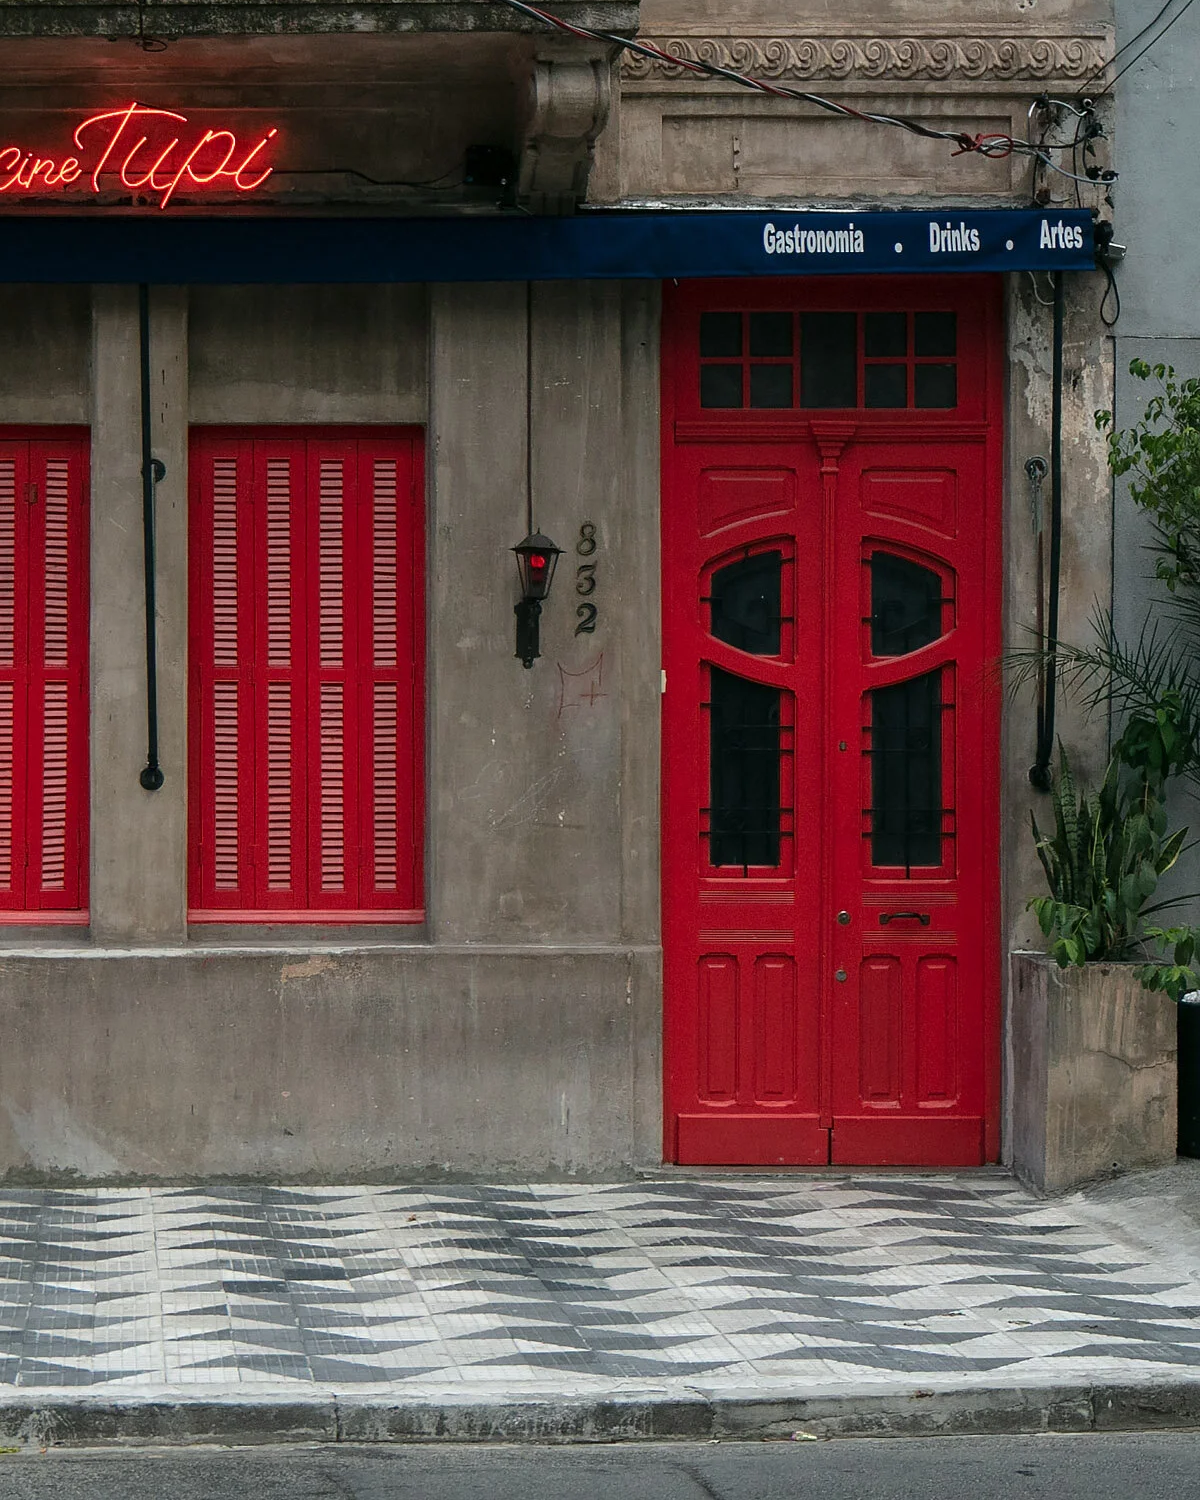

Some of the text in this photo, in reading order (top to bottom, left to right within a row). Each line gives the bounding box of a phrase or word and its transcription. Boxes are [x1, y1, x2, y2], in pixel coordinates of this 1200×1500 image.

[73, 101, 278, 210] Tupi
[763, 219, 1084, 254] Gastronomia Drinks Artes
